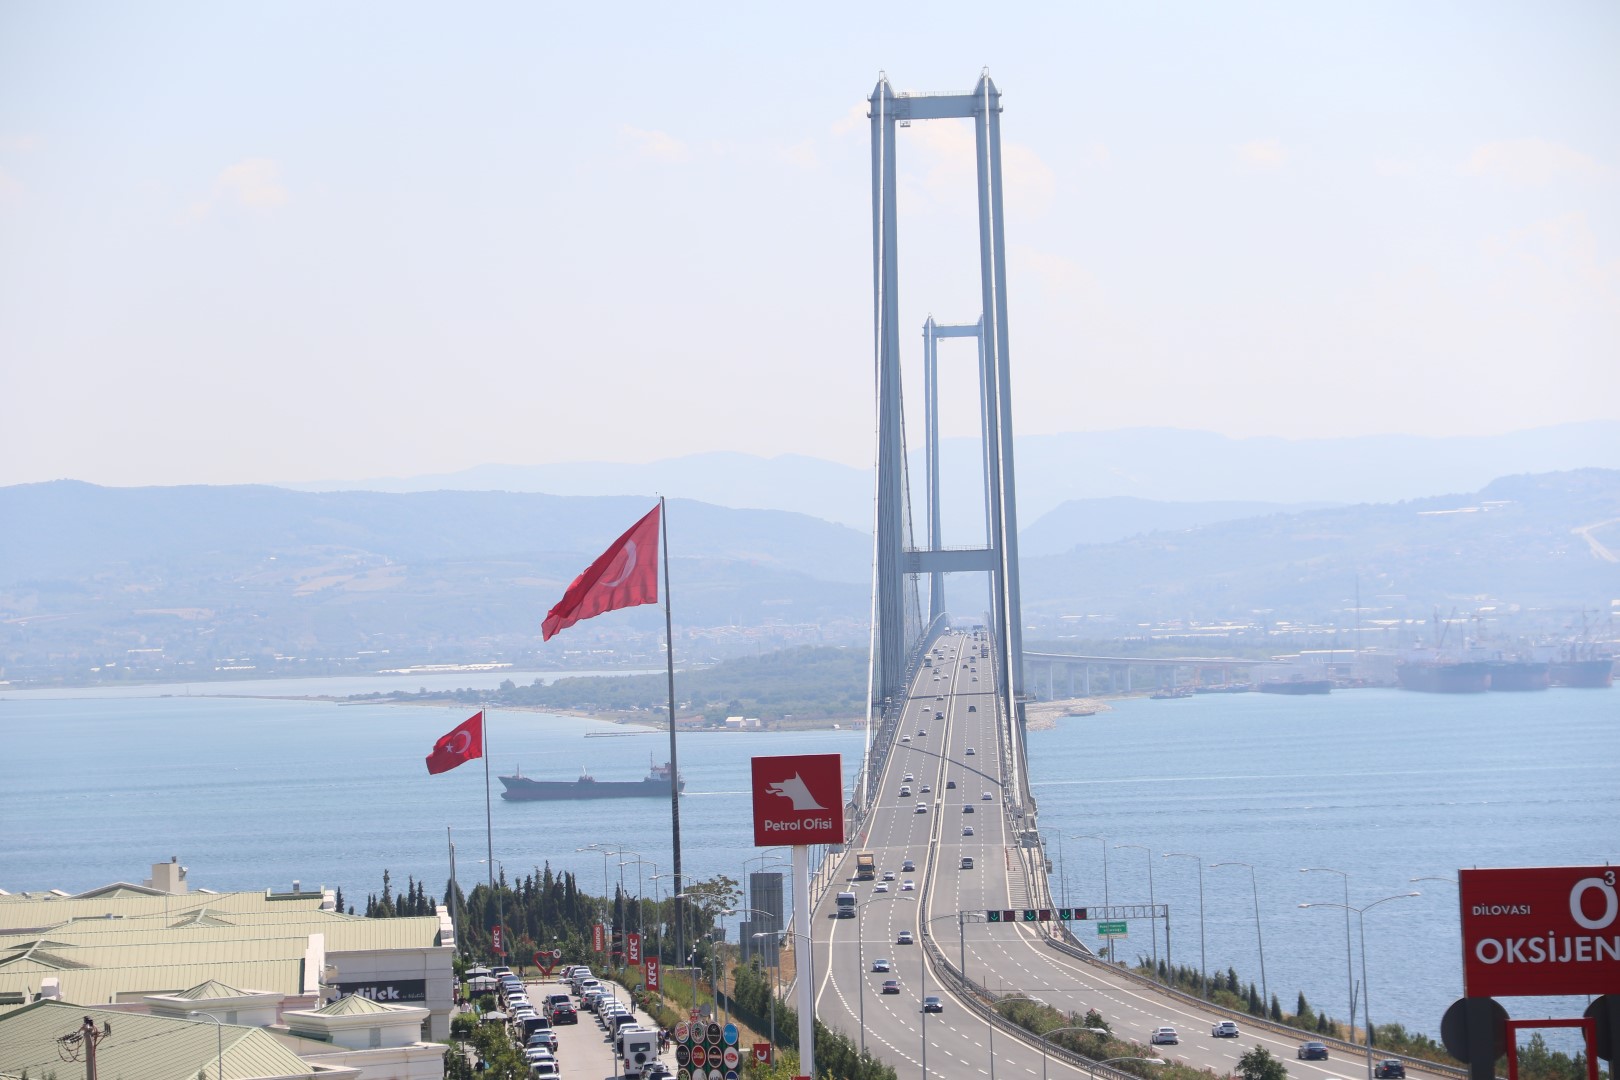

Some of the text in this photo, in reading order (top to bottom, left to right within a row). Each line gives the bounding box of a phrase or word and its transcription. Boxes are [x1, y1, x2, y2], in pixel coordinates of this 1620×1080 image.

[764, 817, 832, 832] Petrol Ofisi
[1472, 903, 1531, 916] DİLOVASI
[493, 930, 501, 948] KFC
[1475, 930, 1620, 965] OKSİJEN
[629, 938, 638, 961] KFC
[647, 962, 657, 986] KFC
